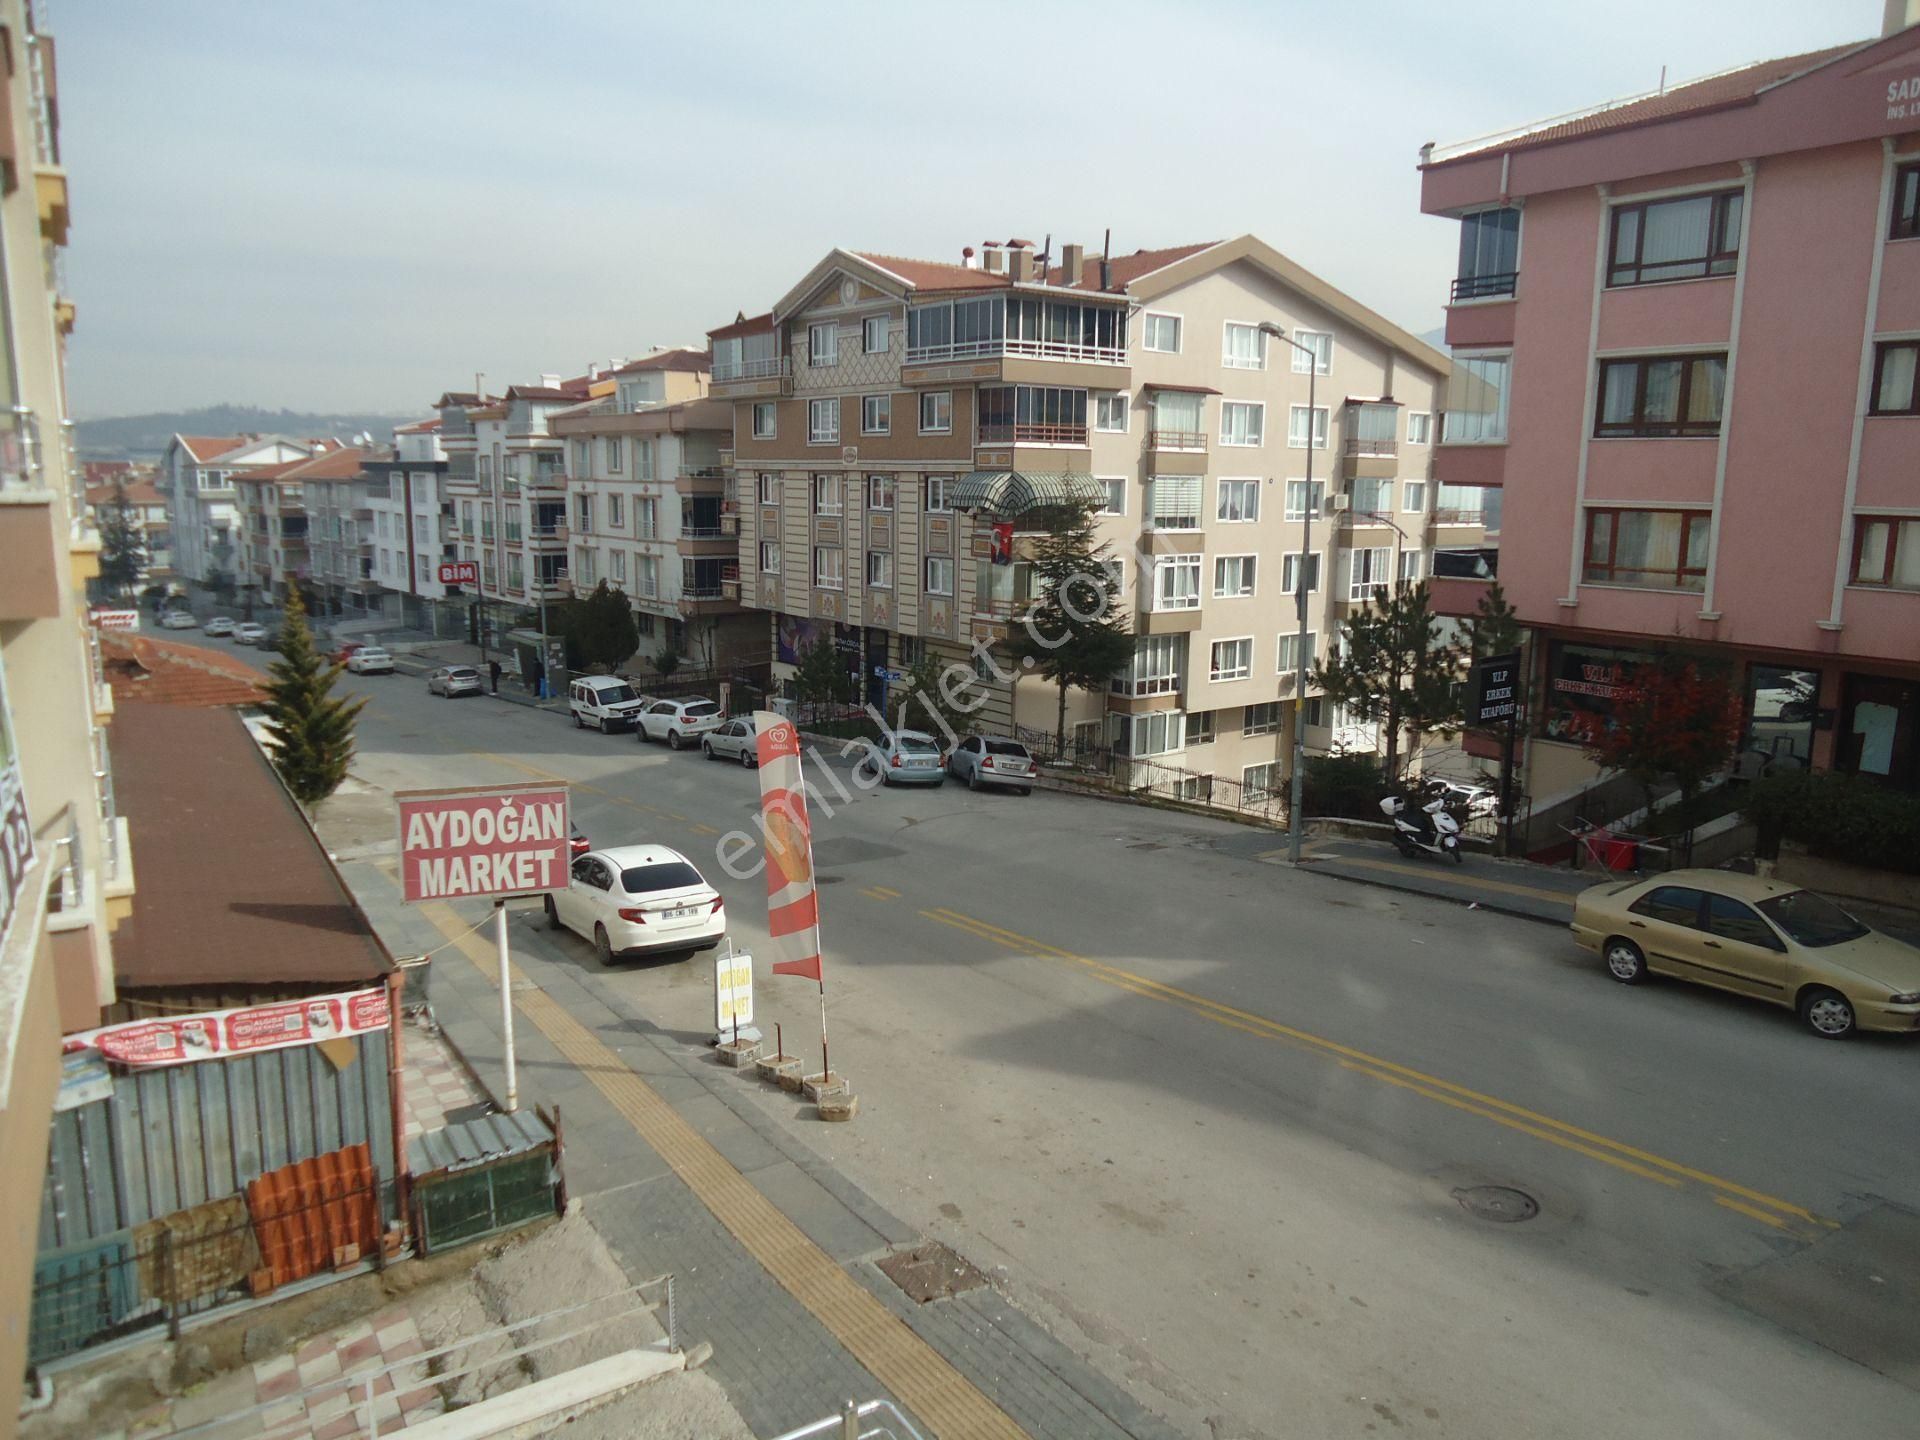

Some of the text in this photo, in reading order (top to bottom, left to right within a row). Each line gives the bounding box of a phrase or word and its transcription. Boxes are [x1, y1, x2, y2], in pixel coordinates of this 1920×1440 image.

[442, 563, 473, 580] BİM
[1486, 687, 1512, 701] ERKEK
[405, 796, 564, 851] AYDOĞAN
[419, 849, 556, 898] MARKET
